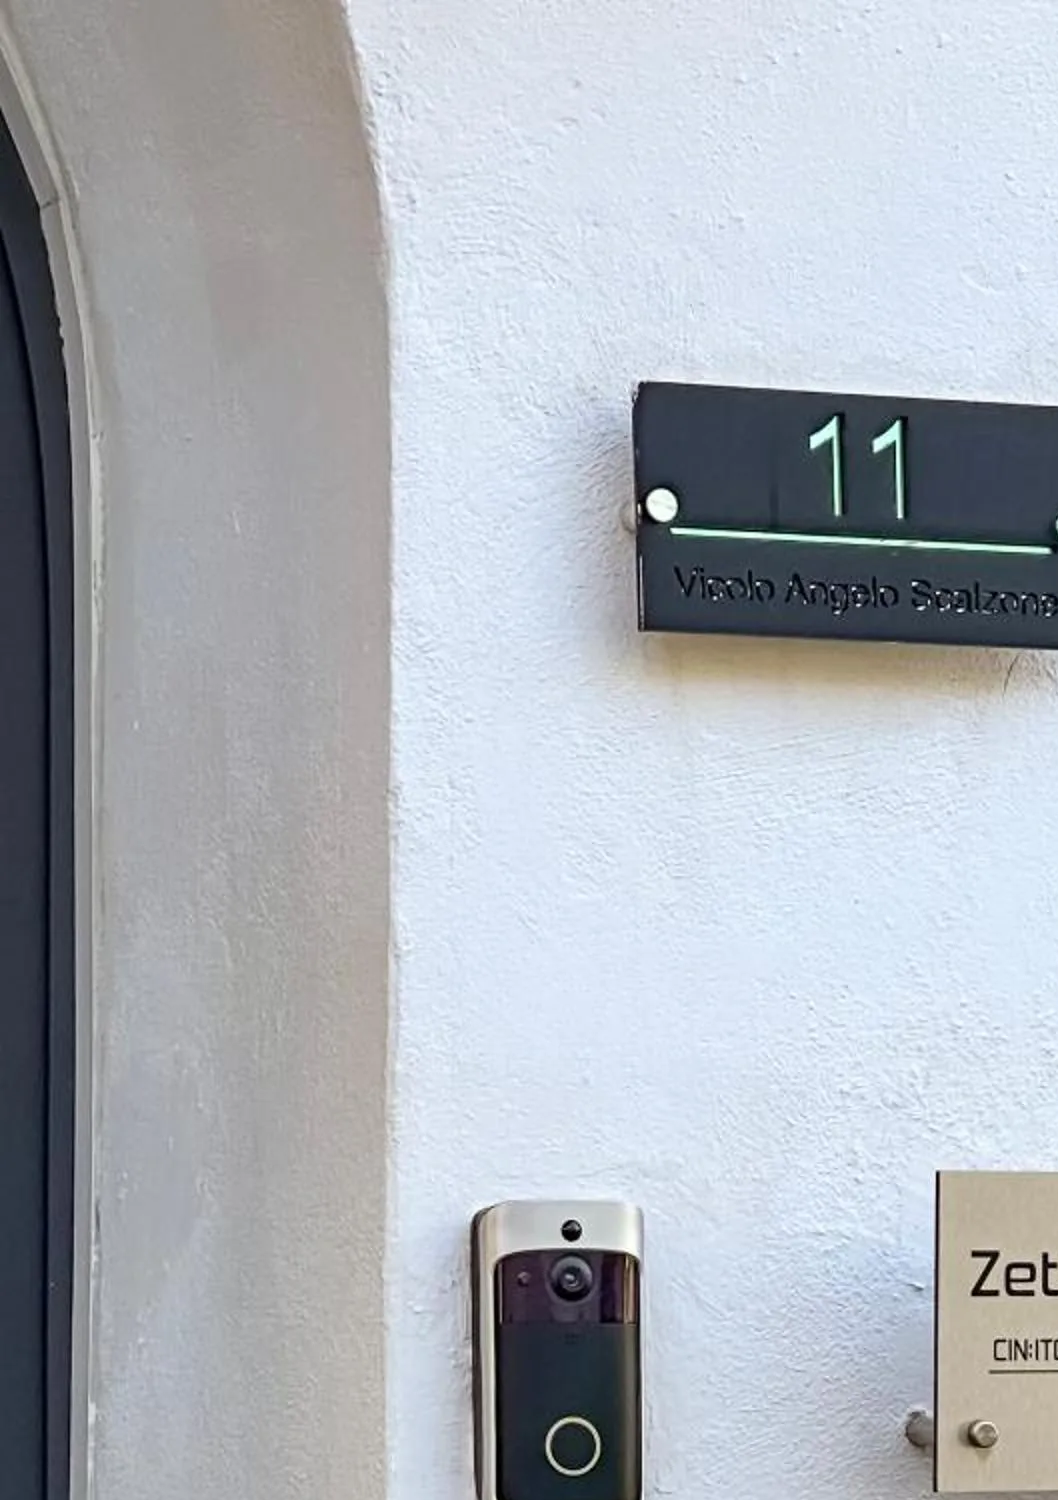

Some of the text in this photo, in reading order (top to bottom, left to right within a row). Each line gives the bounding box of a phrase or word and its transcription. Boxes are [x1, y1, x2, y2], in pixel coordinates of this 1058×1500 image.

[808, 414, 907, 520] 11
[673, 565, 775, 602] Vicolo
[784, 572, 899, 617] Angelo
